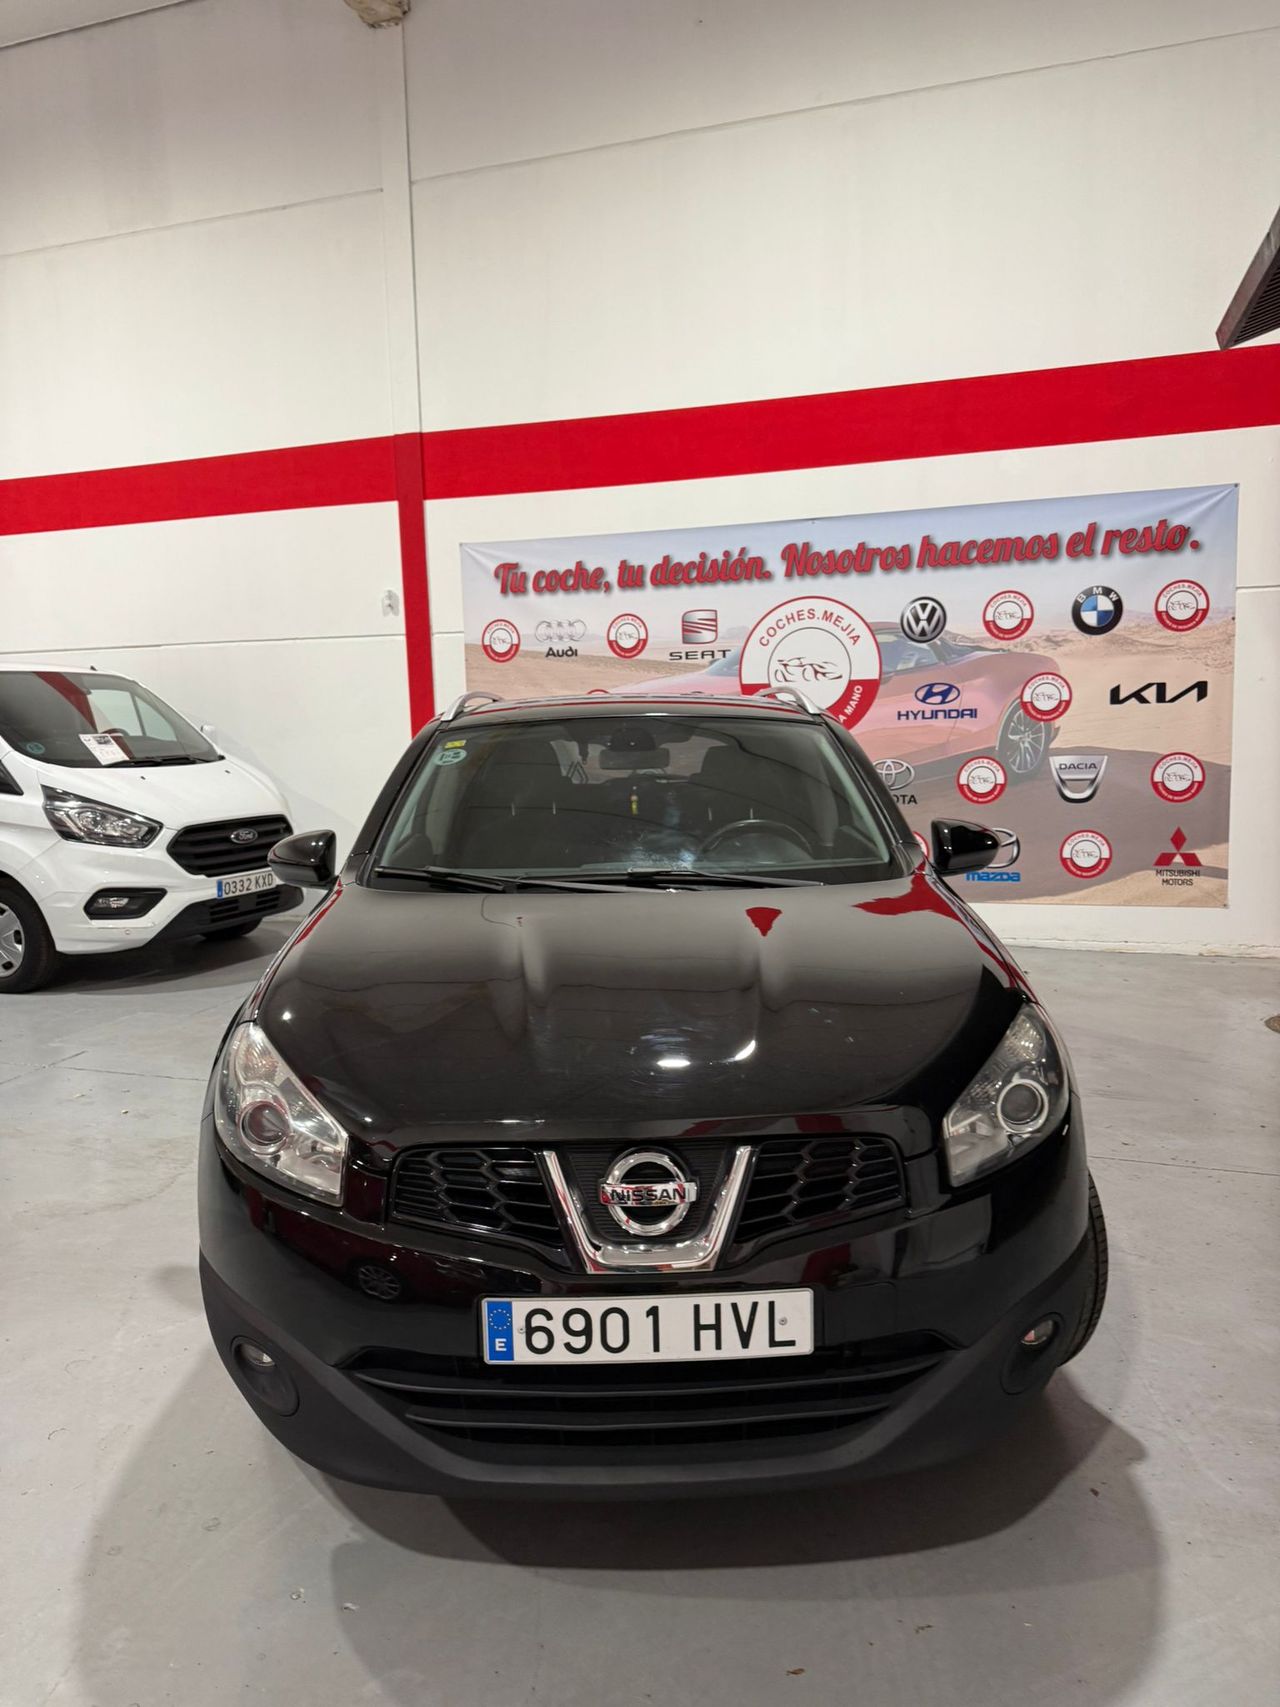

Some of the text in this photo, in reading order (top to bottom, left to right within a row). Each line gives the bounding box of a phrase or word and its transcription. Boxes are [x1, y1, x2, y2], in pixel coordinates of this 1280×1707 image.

[494, 518, 1200, 594] Tu coche, tu decisión. Nosotros hacemos el resto.
[1076, 586, 1119, 603] BMW
[759, 608, 861, 648] COCHES.MEJIA
[545, 646, 578, 658] Audi
[669, 649, 732, 661] SEAT
[844, 685, 863, 715] MANO
[1110, 680, 1208, 705] KIA
[897, 708, 977, 720] HYUNDAI
[965, 871, 1021, 882] mazda
[1155, 869, 1200, 877] MITSUBISHI
[224, 873, 274, 895] 0332 KXD
[1162, 878, 1193, 886] MOTORS
[610, 1187, 686, 1202] NISSAN
[495, 1300, 796, 1355] E 6901 HVL
